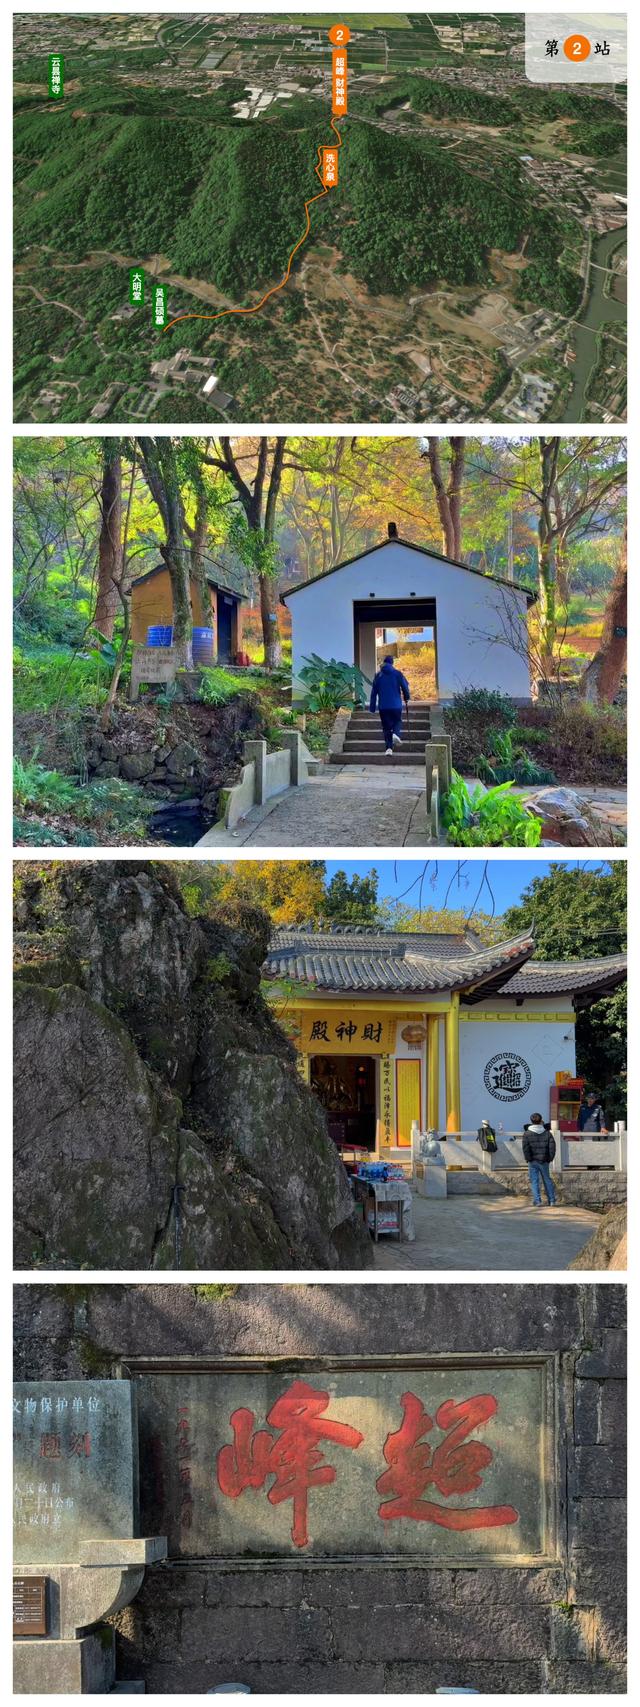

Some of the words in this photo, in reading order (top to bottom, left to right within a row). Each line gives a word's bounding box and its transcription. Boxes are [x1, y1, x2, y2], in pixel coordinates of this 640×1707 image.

[13, 1397, 101, 1413] 文物保护单位
